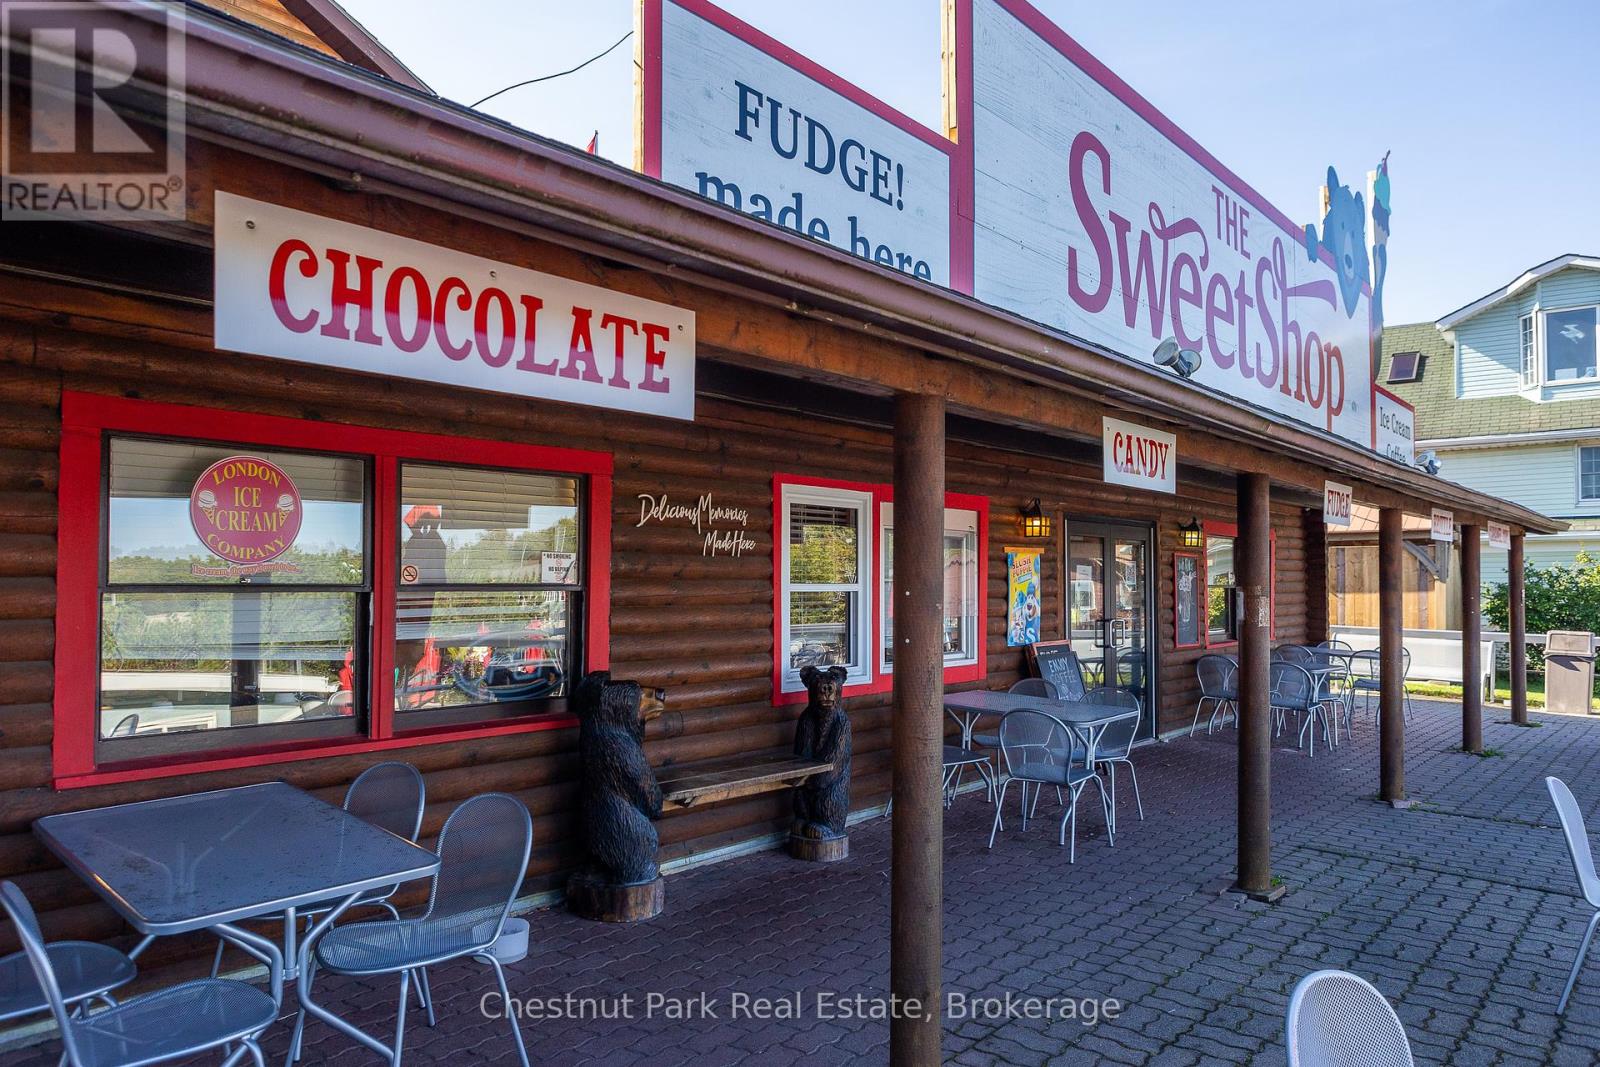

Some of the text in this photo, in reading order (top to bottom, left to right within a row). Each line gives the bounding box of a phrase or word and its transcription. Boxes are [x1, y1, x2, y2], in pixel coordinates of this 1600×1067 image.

[735, 80, 904, 211] FUDGE!
[695, 172, 931, 281] made here
[1212, 184, 1251, 260] THE
[269, 239, 671, 394] CHOCOLATE
[1380, 406, 1411, 440] Ice Cream
[1113, 431, 1169, 480] CANDY
[212, 462, 281, 488] LONDON
[234, 486, 262, 508] ICE
[1326, 489, 1350, 519] FUDGE
[215, 509, 278, 532] CREAM
[207, 533, 285, 560] COMPANY
[1048, 657, 1070, 673] ENJOY
